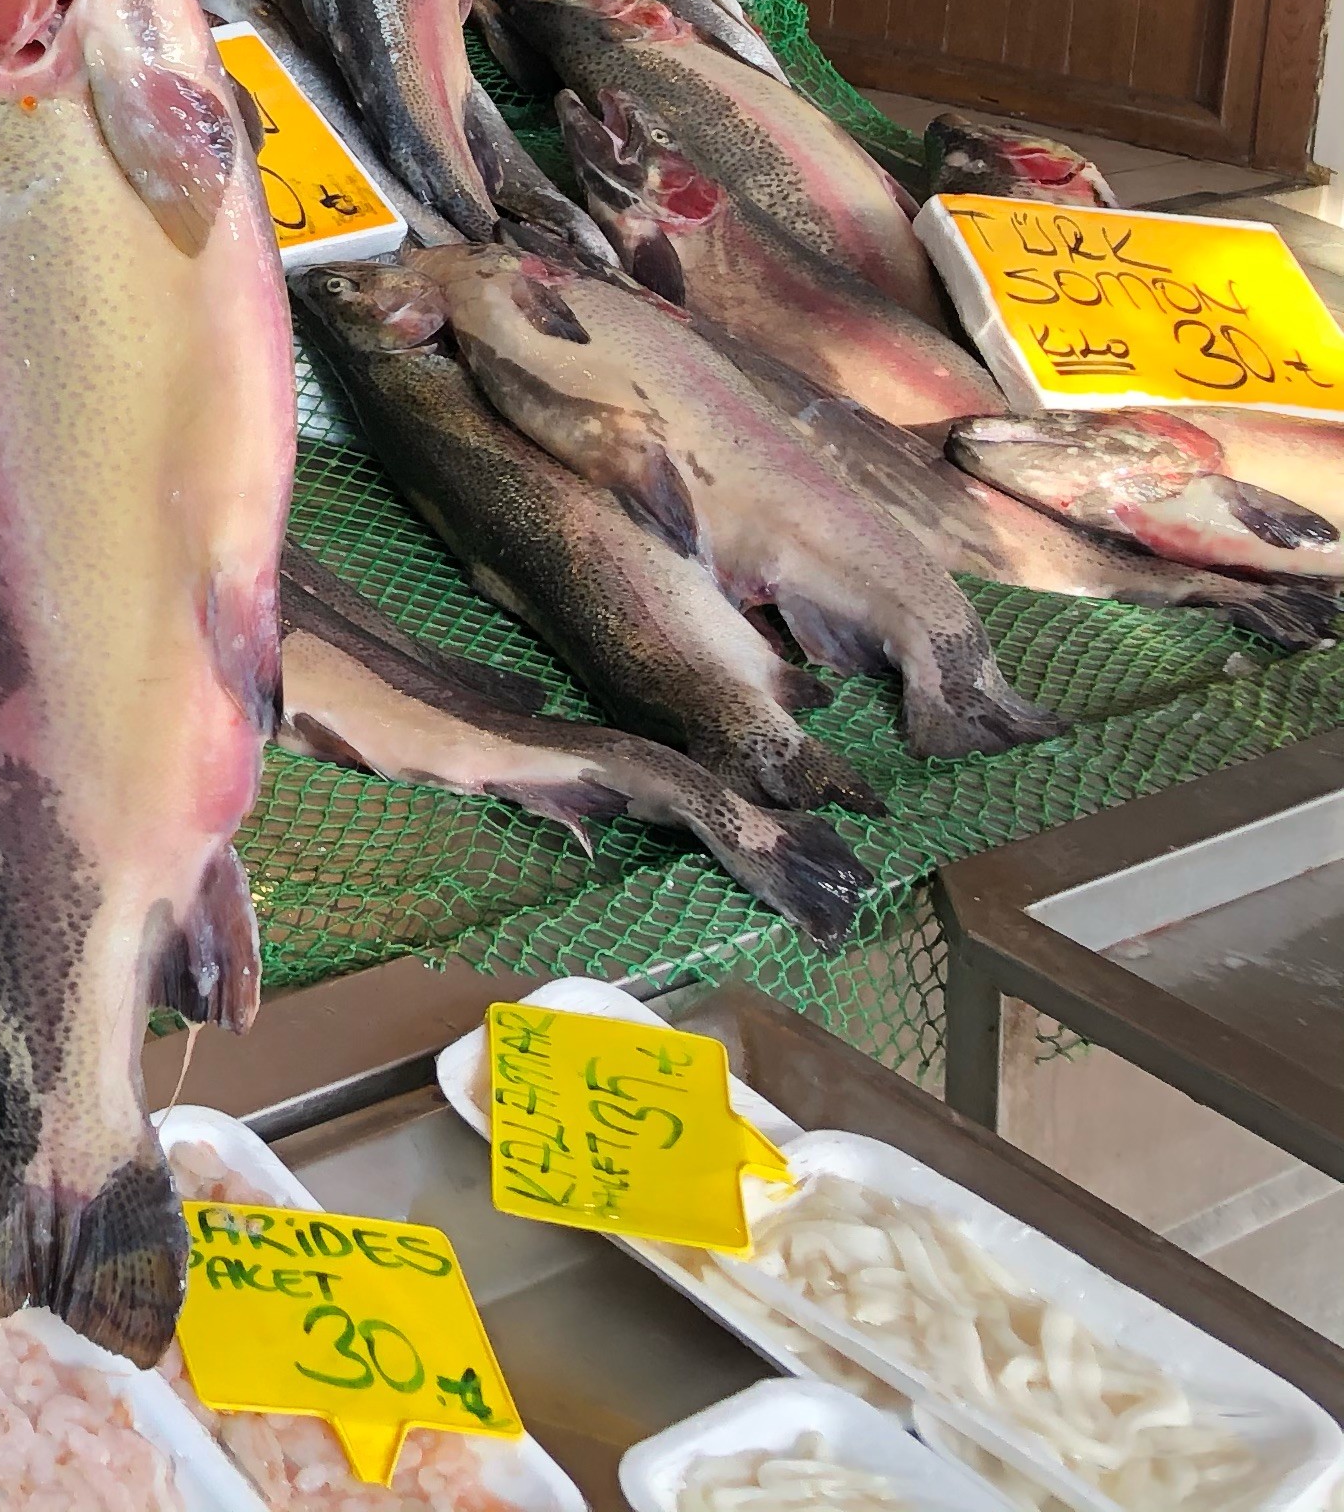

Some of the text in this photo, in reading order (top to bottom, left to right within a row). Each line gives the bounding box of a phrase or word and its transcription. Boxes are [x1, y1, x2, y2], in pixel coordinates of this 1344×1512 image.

[948, 210, 1173, 274] TÜRK
[1003, 267, 1250, 319] SOMON
[495, 1011, 578, 1207] KALAMAR
